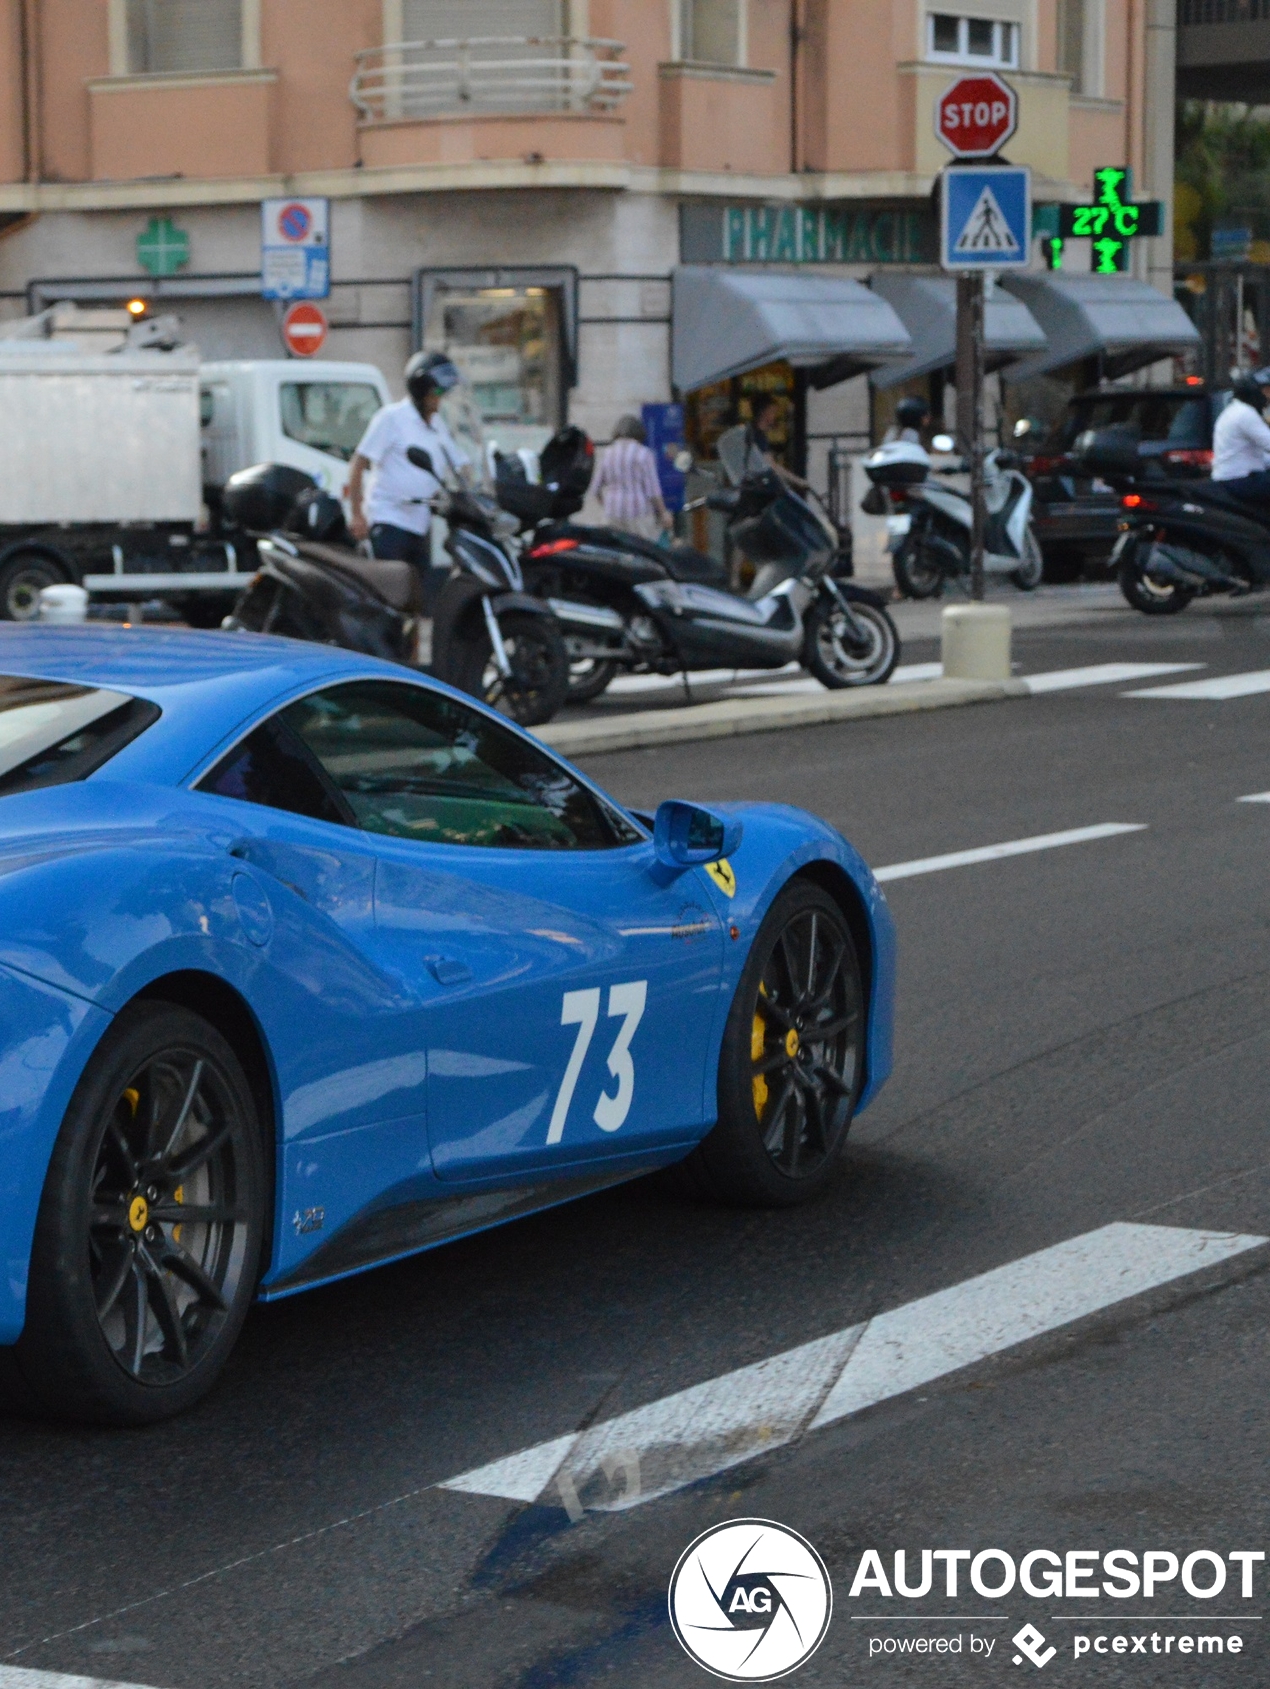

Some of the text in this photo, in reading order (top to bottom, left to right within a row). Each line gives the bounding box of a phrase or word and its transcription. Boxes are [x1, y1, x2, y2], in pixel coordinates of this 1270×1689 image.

[943, 102, 1007, 128] STOP
[723, 206, 923, 262] PHARMACIE
[546, 980, 648, 1145] 73
